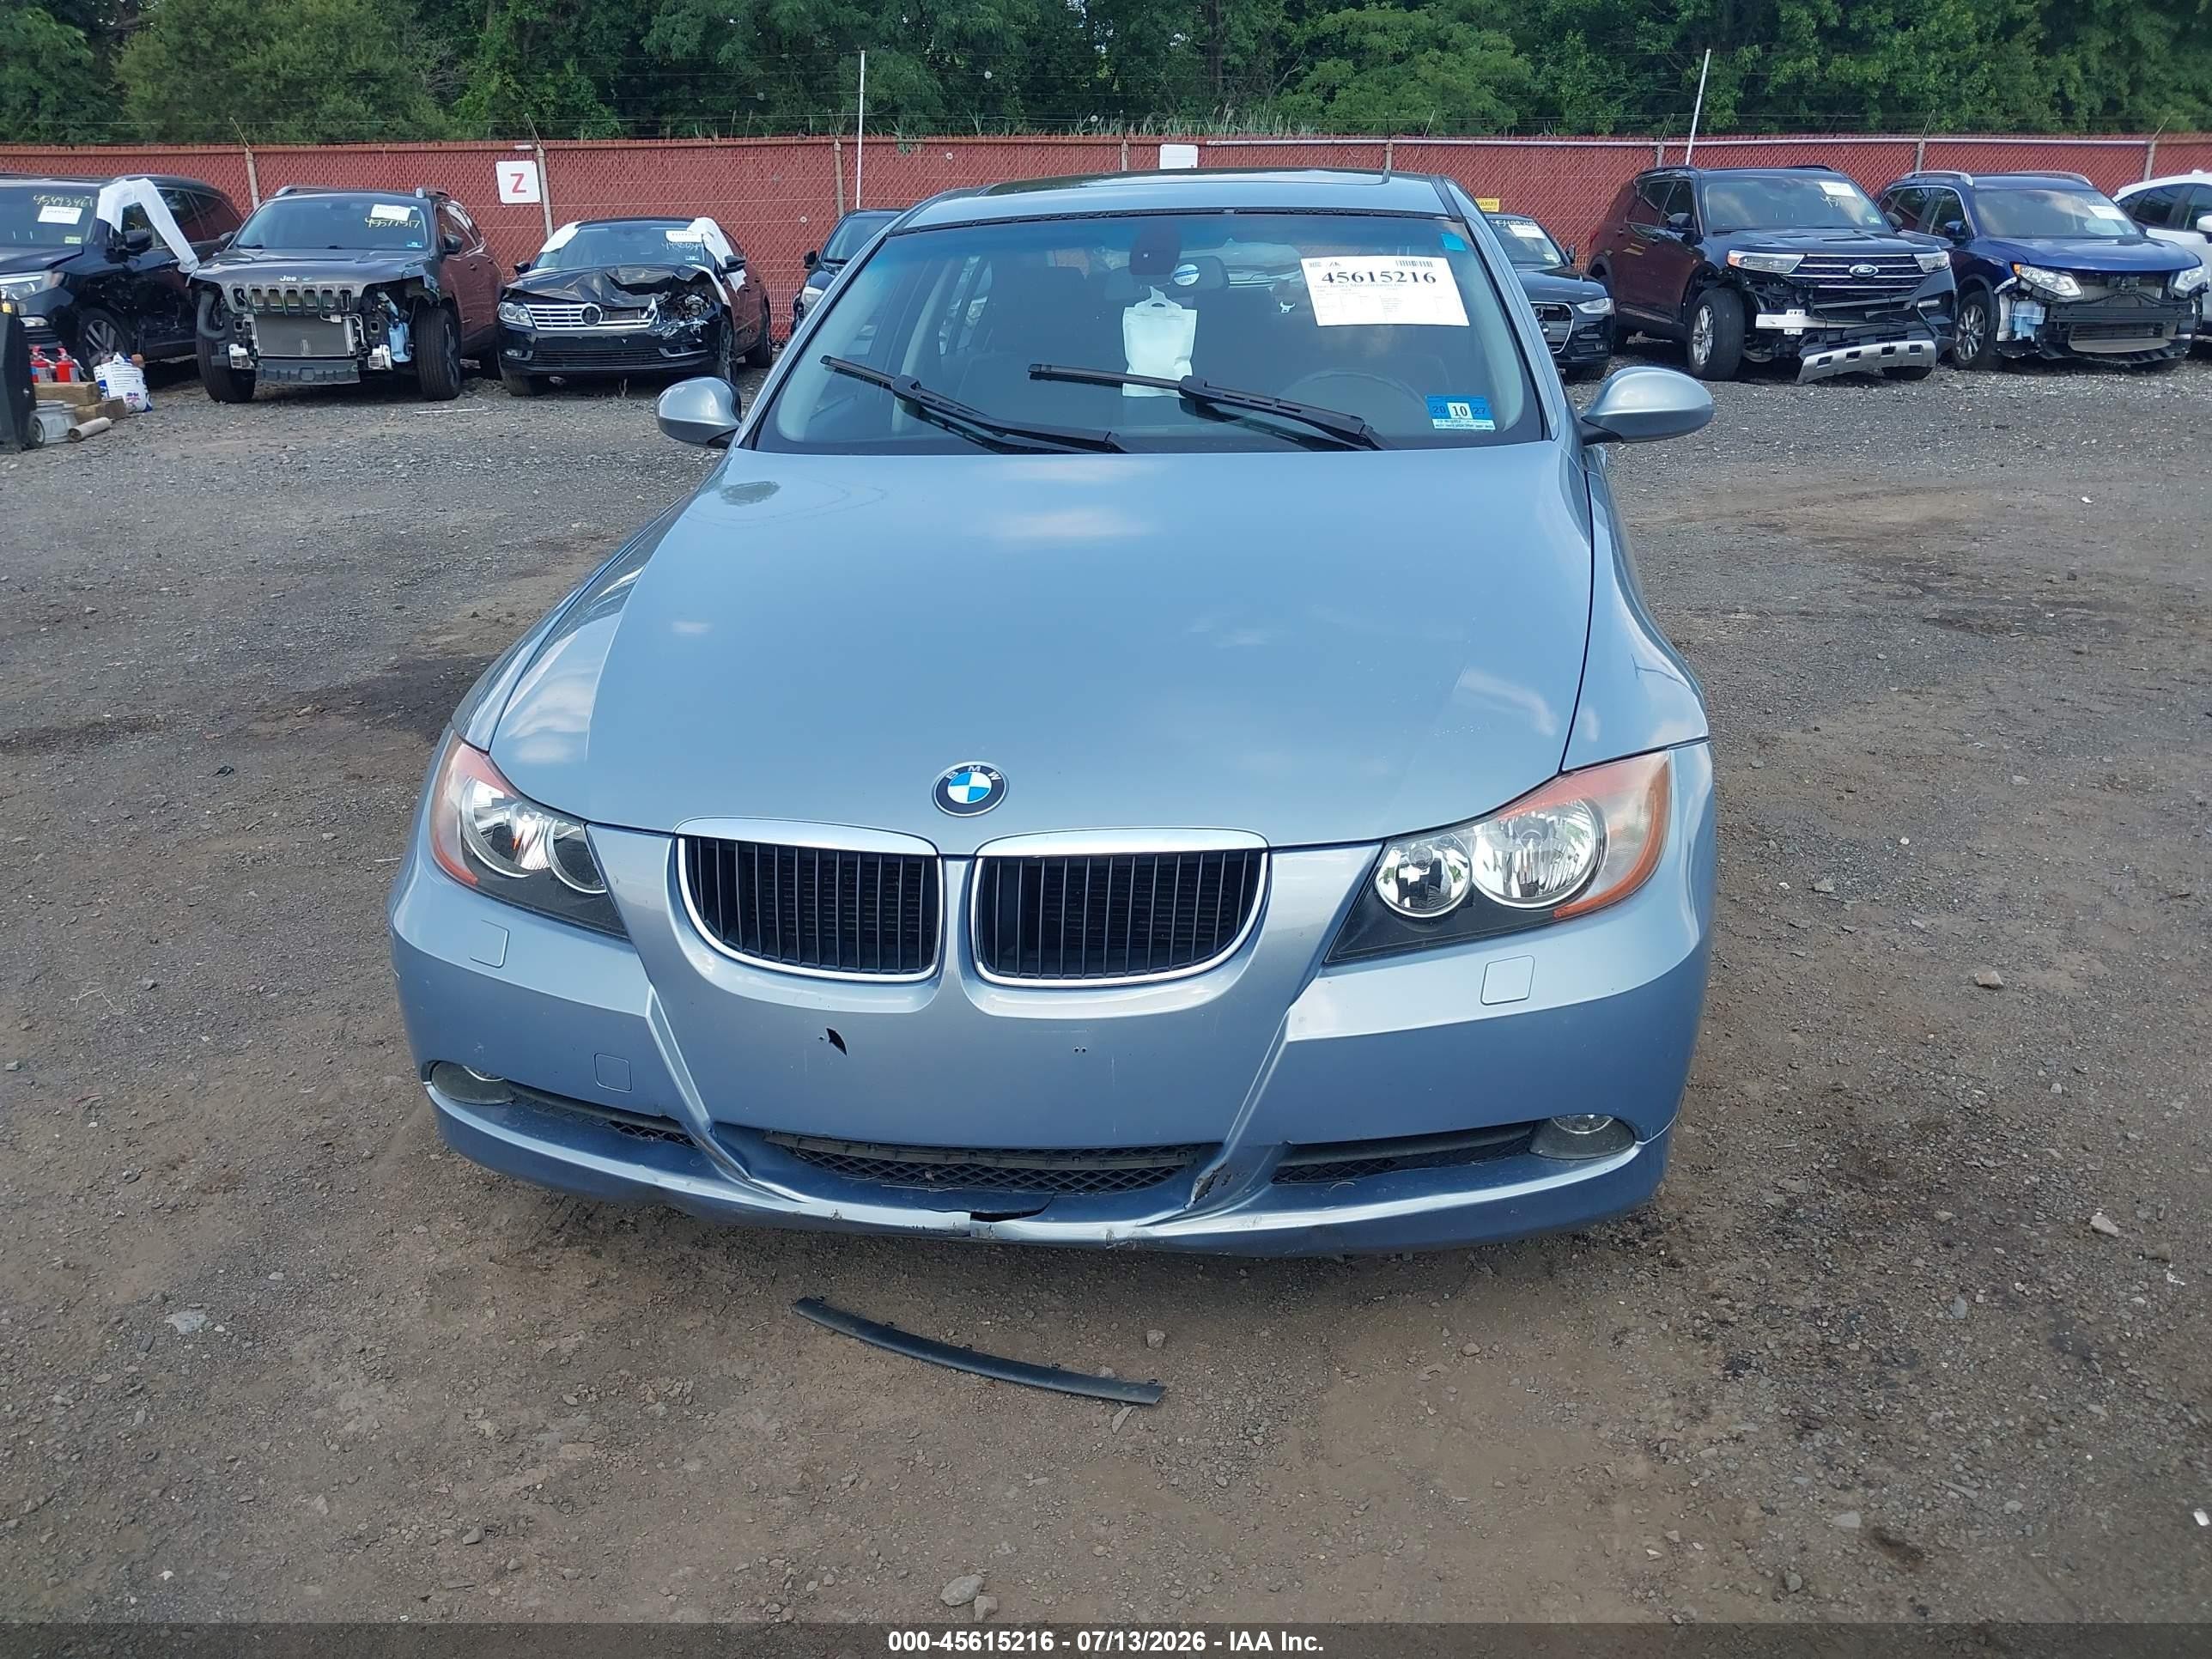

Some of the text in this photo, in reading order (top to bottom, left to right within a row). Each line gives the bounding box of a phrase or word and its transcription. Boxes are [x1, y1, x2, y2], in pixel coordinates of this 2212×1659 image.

[510, 173, 527, 193] Z
[1321, 270, 1437, 284] 45615216
[1451, 405, 1468, 416] 10
[945, 765, 1002, 781] BMW
